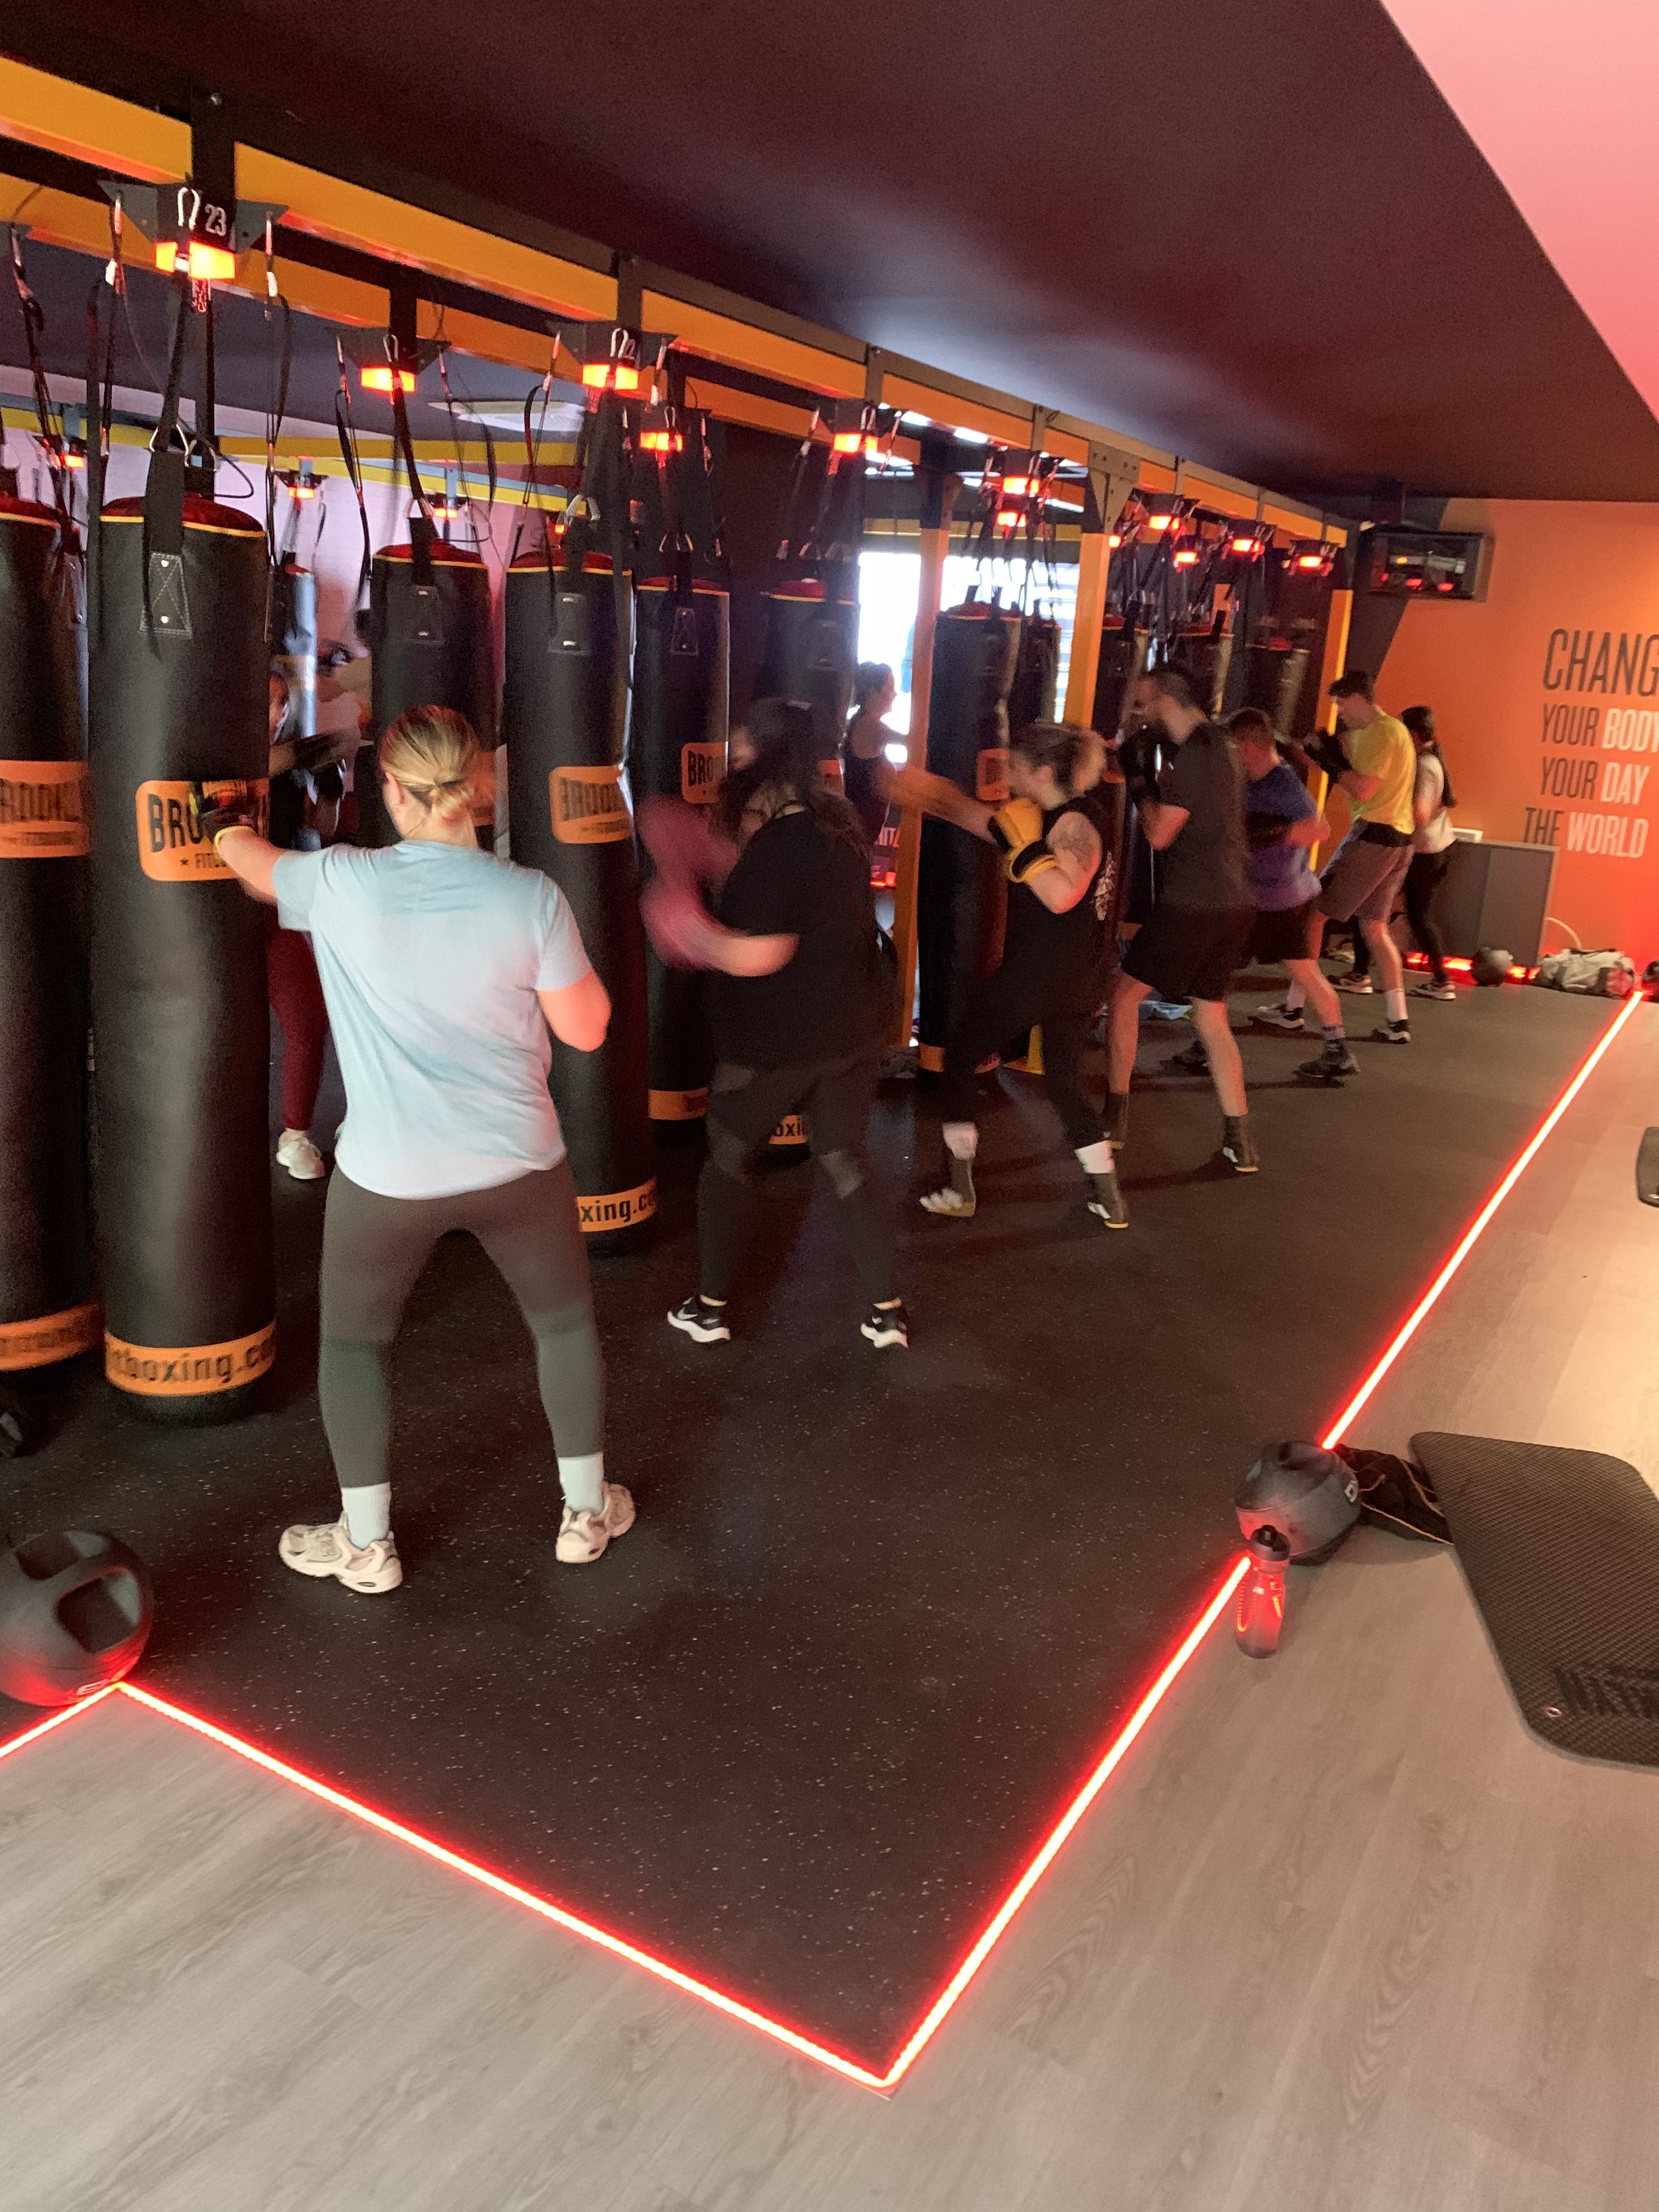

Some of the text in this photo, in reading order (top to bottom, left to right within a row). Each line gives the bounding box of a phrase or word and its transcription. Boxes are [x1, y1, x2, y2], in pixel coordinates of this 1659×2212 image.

[204, 204, 227, 236] 23
[1543, 628, 1659, 697] CHANG
[1542, 703, 1600, 747] YOUR
[1540, 756, 1650, 805] YOUR DAY
[1567, 811, 1649, 858] WORLD
